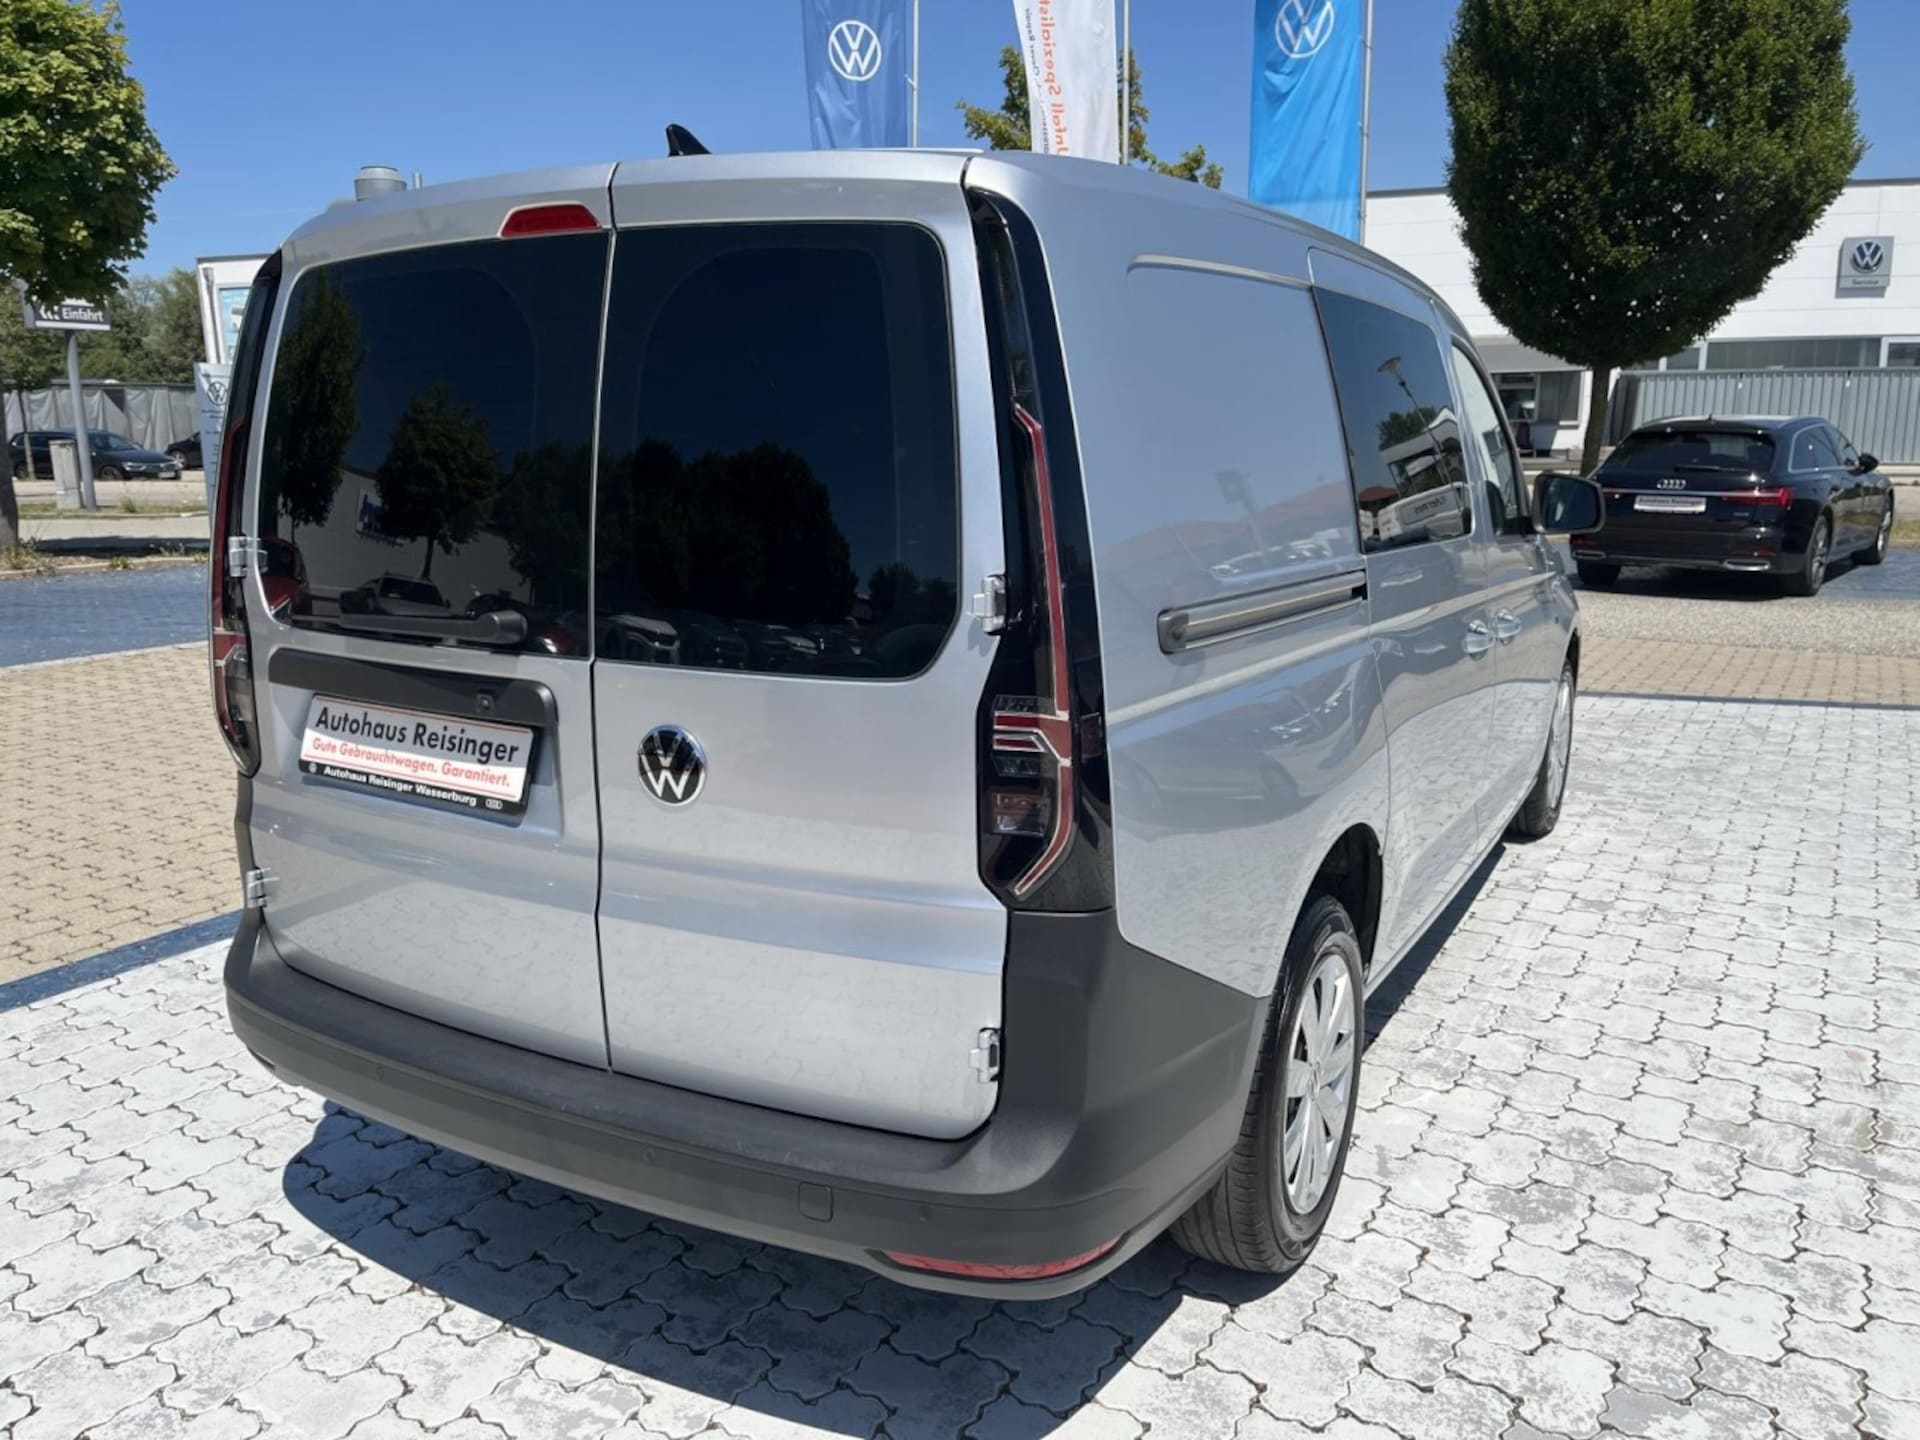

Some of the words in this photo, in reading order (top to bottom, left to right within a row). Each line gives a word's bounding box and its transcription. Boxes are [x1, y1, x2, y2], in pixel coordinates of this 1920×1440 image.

[61, 307, 104, 322] Einfahrt
[315, 706, 407, 743] Autohaus
[412, 722, 519, 765] Reisinger
[312, 737, 337, 753] Gute
[340, 742, 438, 773] Gebrauchtwagen.
[441, 761, 510, 787] Garantiert.
[323, 765, 368, 783] Autohaus
[368, 774, 414, 793] Reisinger
[415, 783, 477, 807] Wasserburg
